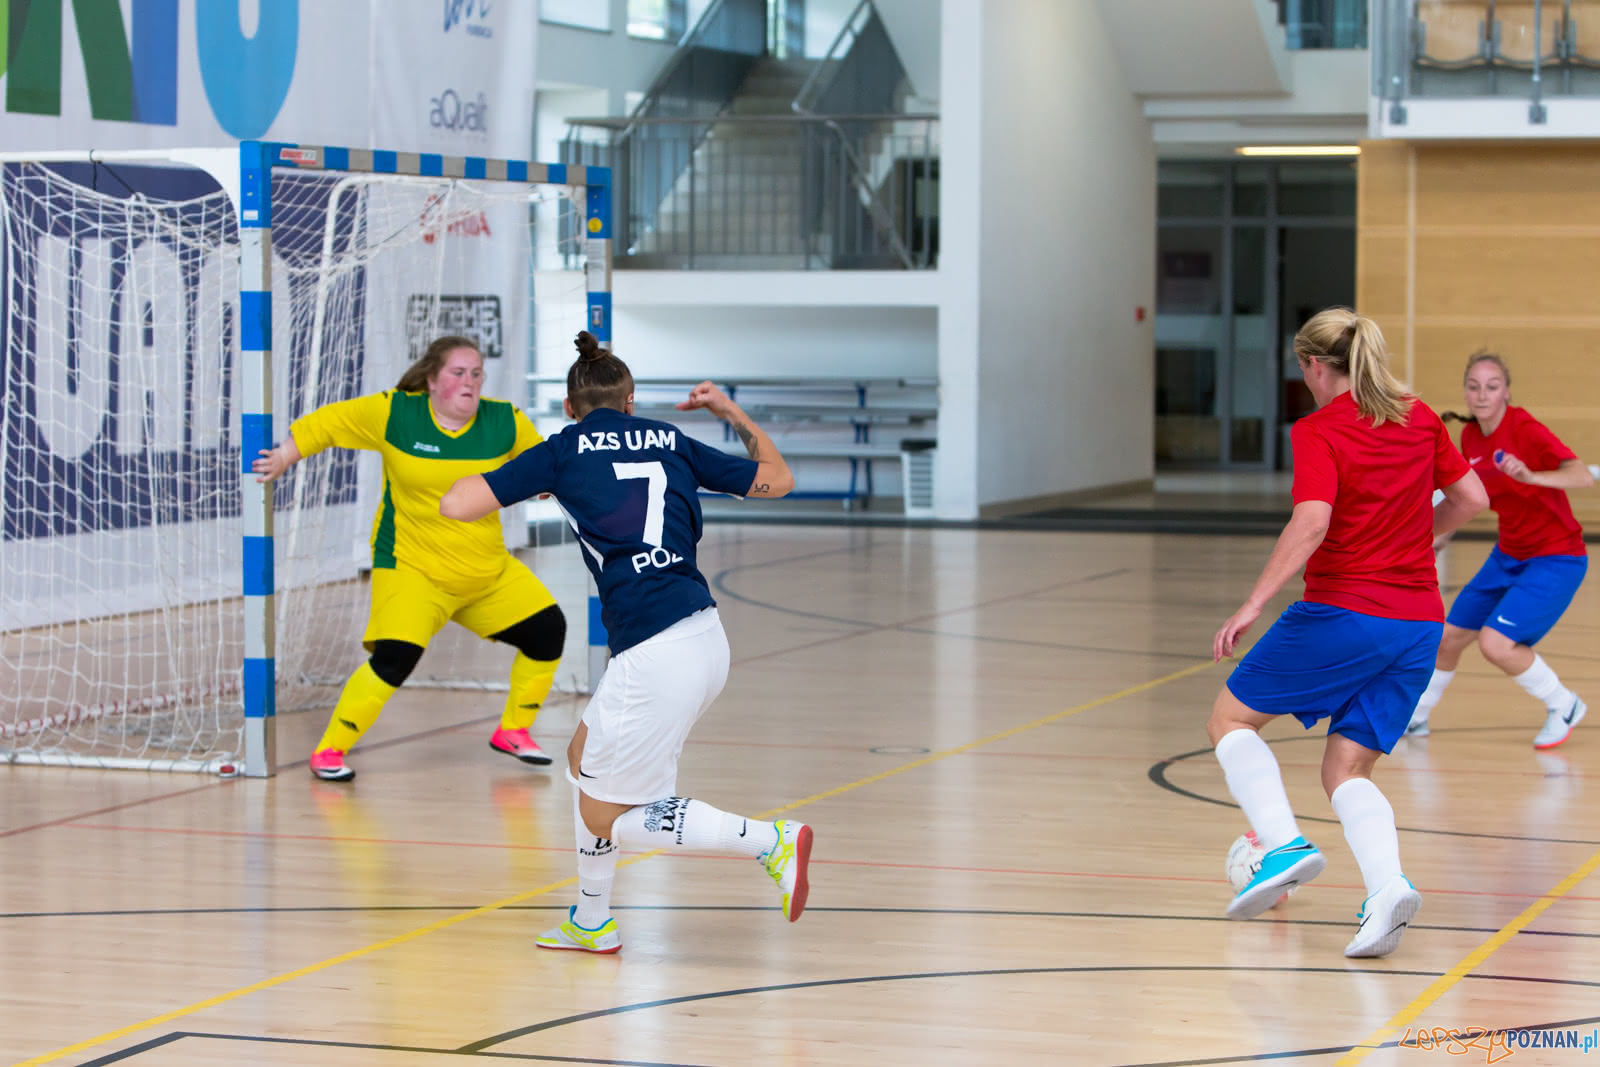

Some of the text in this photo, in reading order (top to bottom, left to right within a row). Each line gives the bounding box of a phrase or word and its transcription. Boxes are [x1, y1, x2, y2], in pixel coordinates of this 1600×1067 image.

[578, 429, 676, 454] AZS UAM
[612, 461, 667, 548] 7
